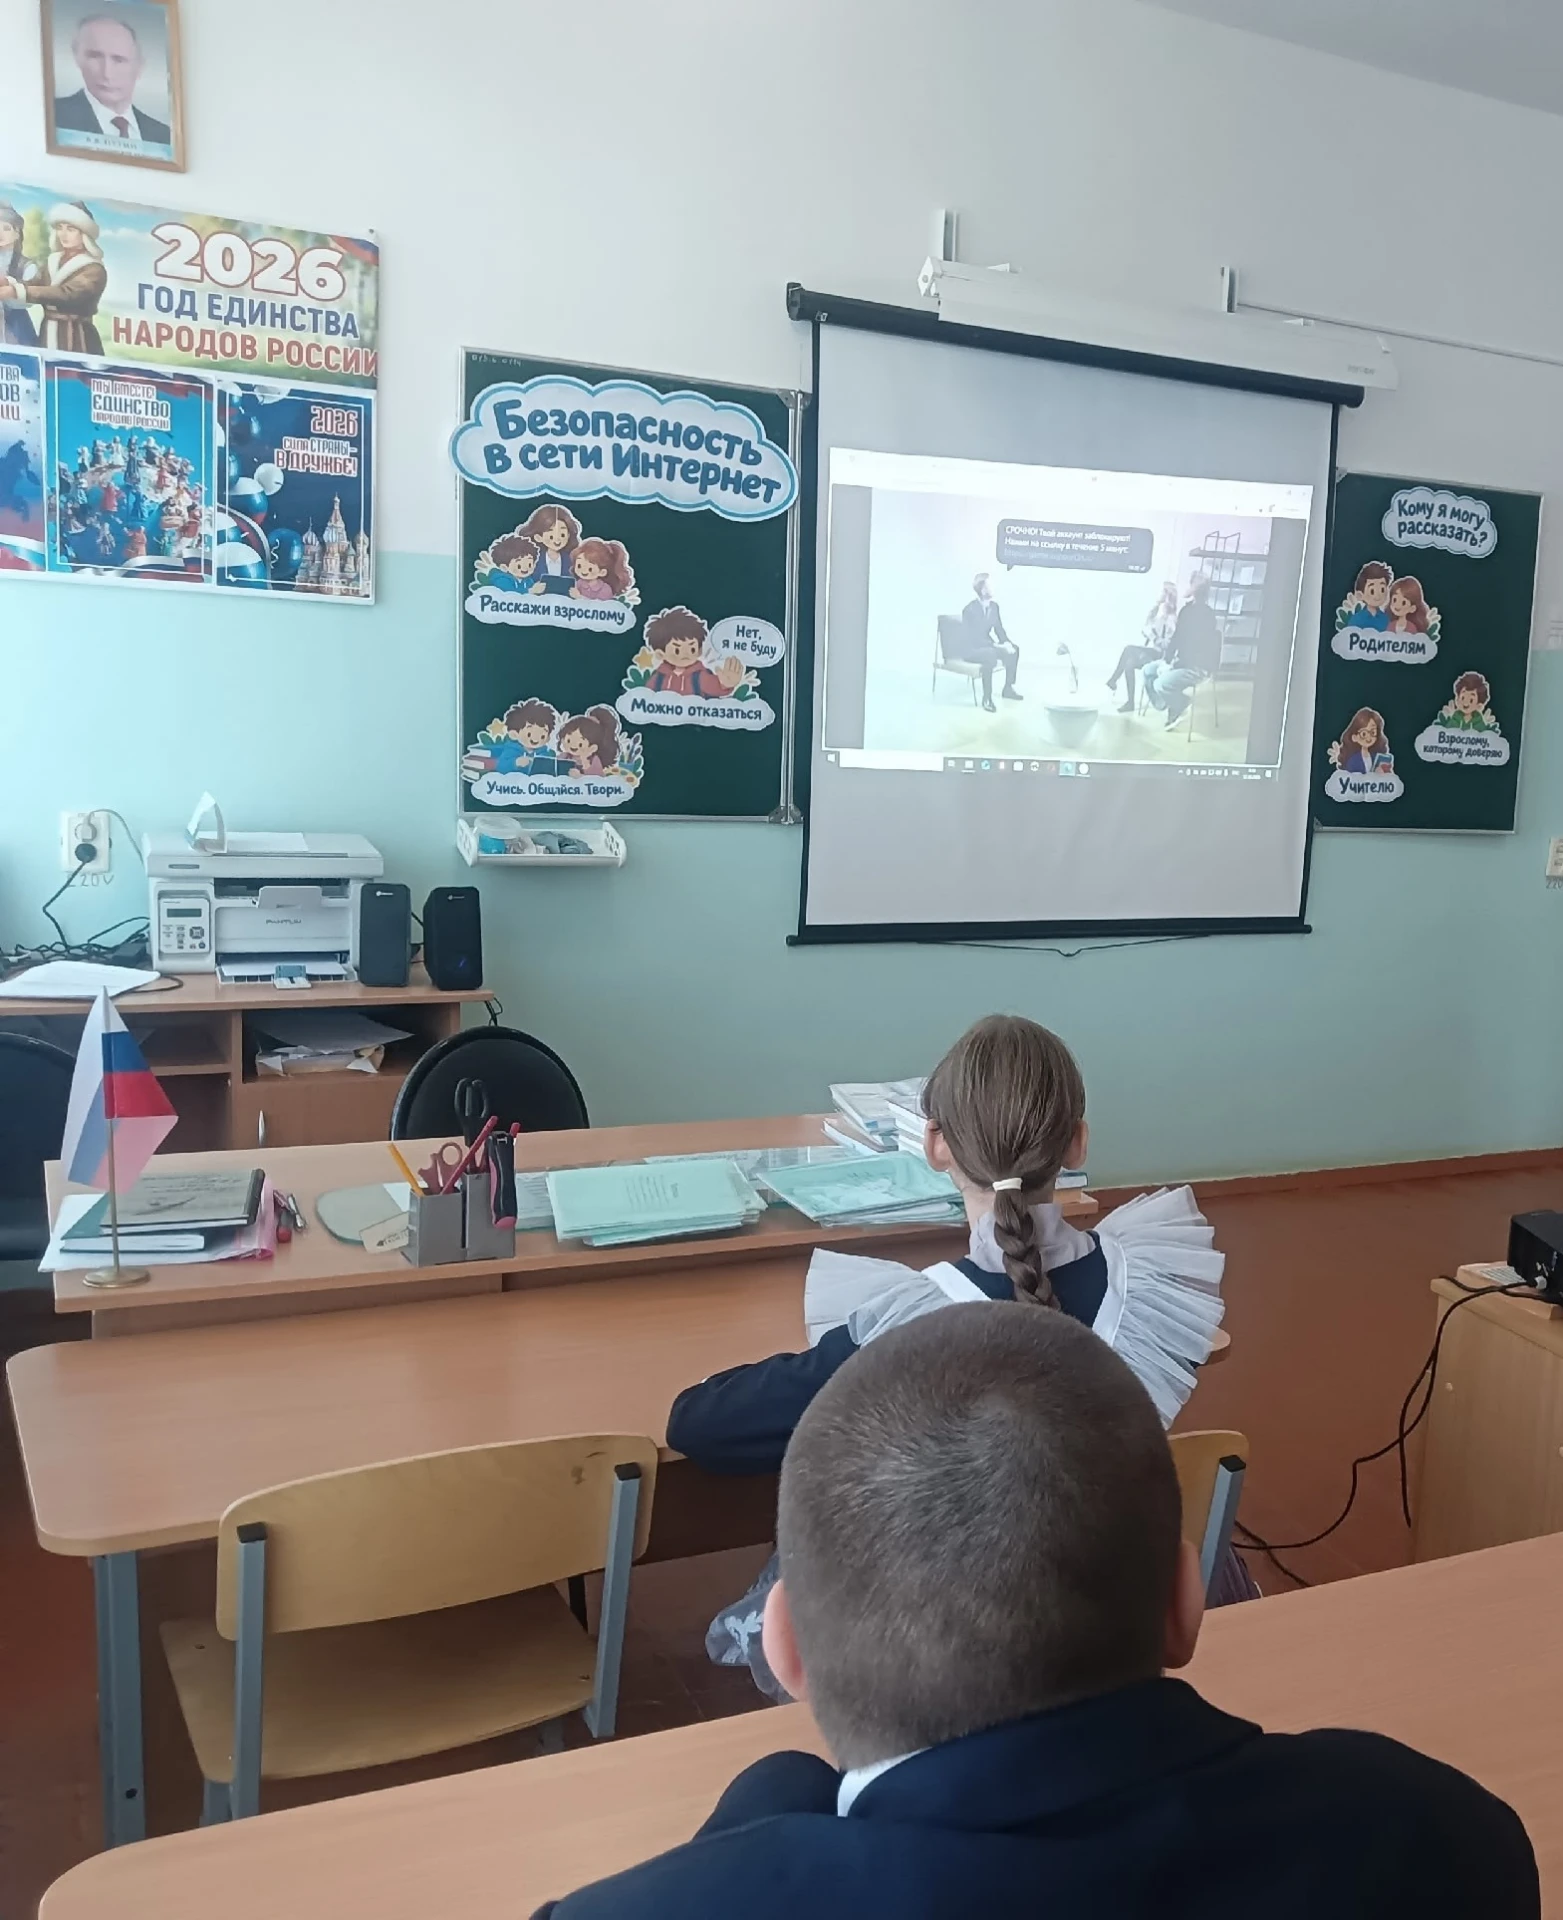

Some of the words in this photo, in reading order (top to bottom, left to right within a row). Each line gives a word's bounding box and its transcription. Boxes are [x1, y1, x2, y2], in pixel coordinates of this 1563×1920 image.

[151, 222, 346, 301] 2026
[138, 283, 198, 321] ГОД
[208, 293, 359, 339] ЕДИНСТВА
[113, 316, 257, 361] НАРОДОВ
[267, 337, 378, 376] РОССИИ
[93, 394, 169, 418] ЕДИНСТВО
[312, 407, 357, 436] 2026
[493, 399, 763, 466] Безопасность
[288, 452, 357, 476] ДРУЖБЕ!
[518, 443, 603, 471] сети
[612, 442, 782, 504] Интернет
[1398, 499, 1434, 519] Кому
[1437, 503, 1447, 518] я
[1450, 506, 1485, 531] могу
[1398, 520, 1488, 547] рассказать?
[480, 594, 551, 615] Расскажи
[554, 605, 625, 625] взрослому
[736, 625, 762, 640] Нет,
[1349, 632, 1426, 655] Родителям
[722, 639, 730, 649] я
[734, 640, 747, 651] не
[751, 640, 777, 659] буду
[631, 698, 683, 716] Можно
[688, 705, 762, 720] отказаться
[1423, 745, 1463, 758] которому
[1438, 731, 1490, 748] Взрослому,
[486, 781, 526, 795] Учись.
[1339, 777, 1394, 794] Учителю
